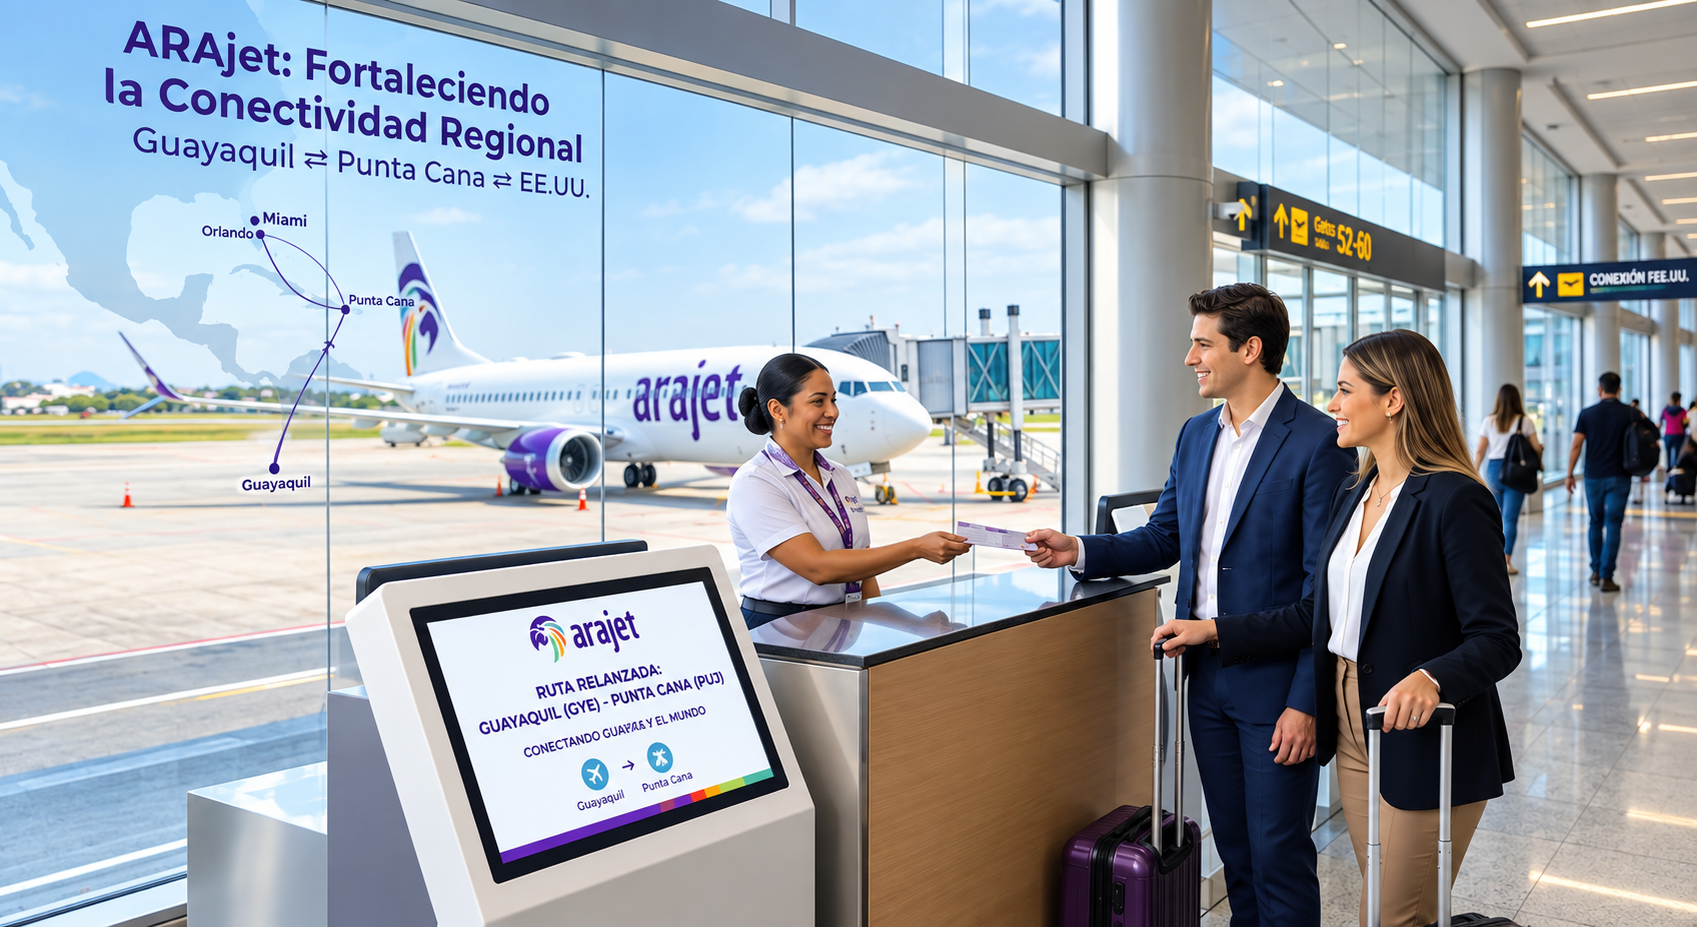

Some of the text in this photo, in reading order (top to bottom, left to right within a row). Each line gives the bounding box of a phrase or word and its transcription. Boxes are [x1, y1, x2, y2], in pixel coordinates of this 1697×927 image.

[122, 20, 550, 116] ARAjet: Fortaleciendo
[105, 67, 582, 164] la Conectividad Regional
[132, 126, 590, 199] Guayaquil Punta Cana EE.UU.
[201, 225, 254, 240] Orlando
[262, 211, 307, 228] Miami
[1336, 223, 1372, 262] 52-60
[1589, 268, 1646, 286] CONEXIÓN
[349, 294, 415, 307] Punta Cana
[633, 359, 743, 441] arajet
[241, 475, 311, 493] Guayaquil
[569, 609, 640, 654] arajet
[535, 663, 663, 700] RUTA RELANZADA:
[478, 706, 563, 735] GUAYAQUIL
[563, 697, 601, 720] (GYE)
[610, 686, 656, 707] PUNTA
[656, 678, 693, 696] CANA
[693, 670, 725, 691] (PUJ)
[523, 730, 601, 758] CONECTANDO
[645, 717, 653, 728] Y
[654, 715, 669, 726] EL
[668, 705, 707, 723] MUNDO
[576, 771, 694, 811] Guayaquil Punta Cana
